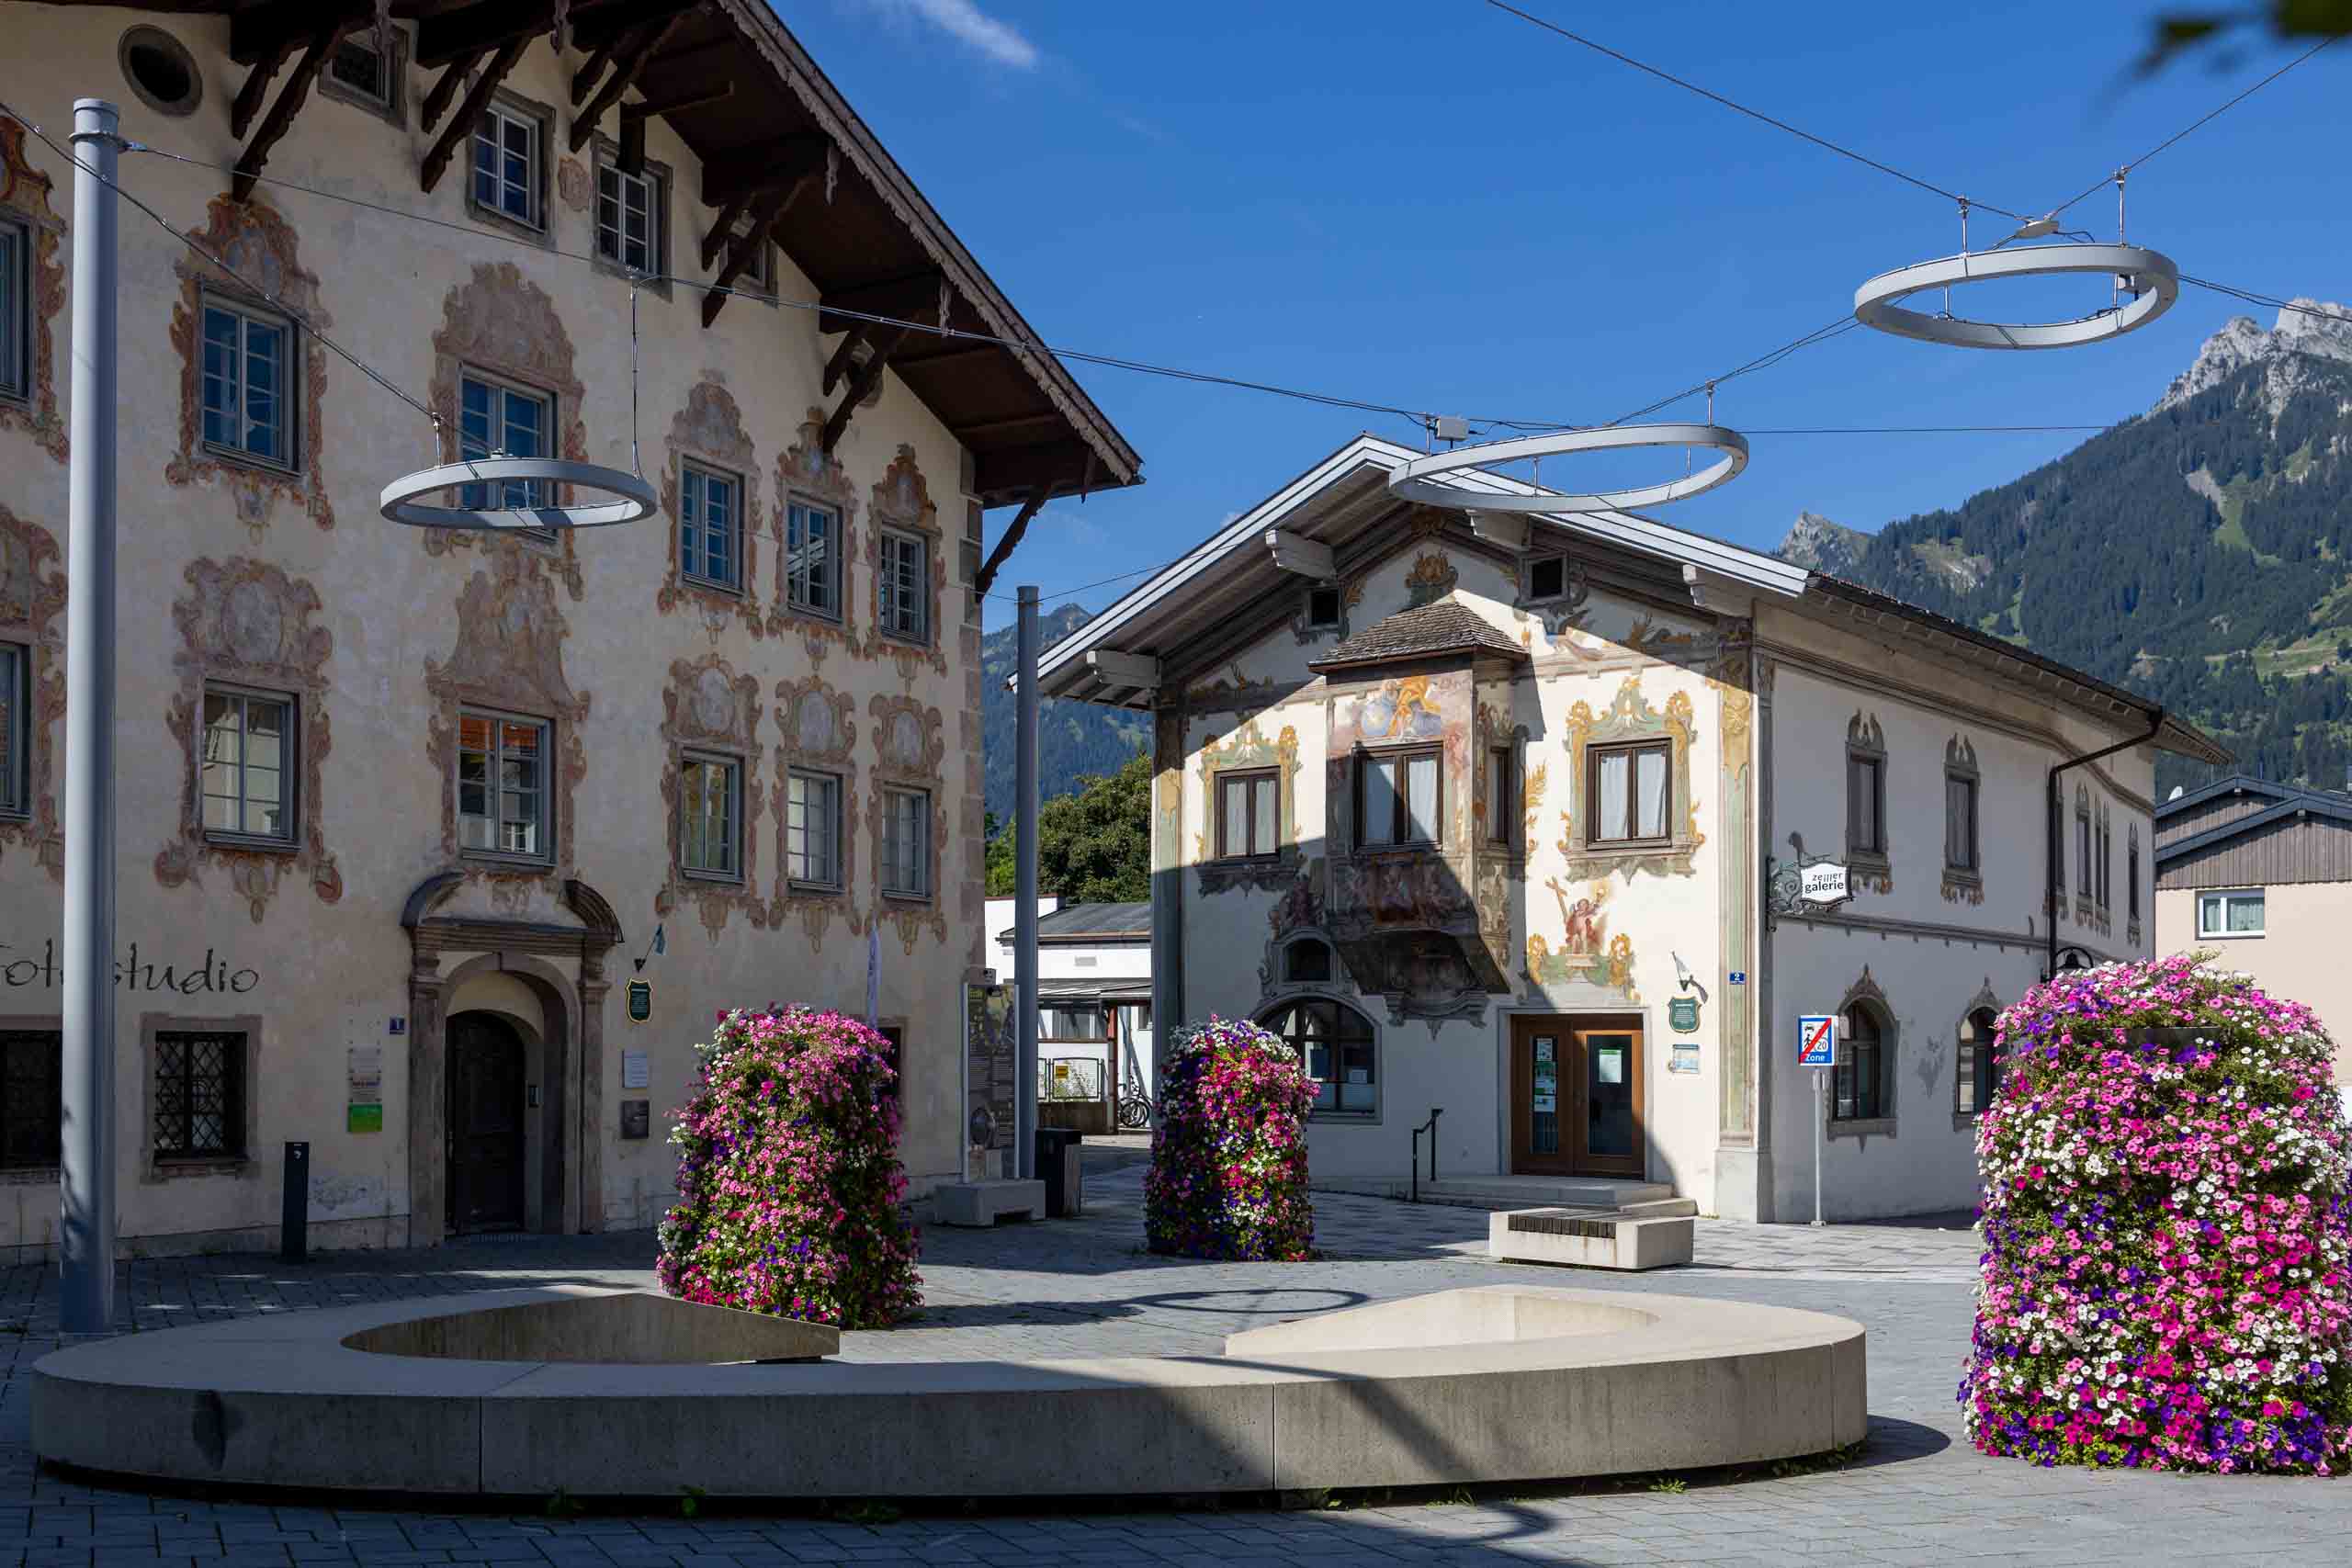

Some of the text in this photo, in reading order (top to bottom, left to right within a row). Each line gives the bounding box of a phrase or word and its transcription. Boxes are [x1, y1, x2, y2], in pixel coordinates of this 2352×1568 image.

[1812, 873, 1843, 882] zeiller
[1804, 880, 1844, 894] galerie
[1734, 972, 1740, 981] 2
[1816, 1041, 1827, 1050] 20
[1804, 1054, 1826, 1062] Zone
